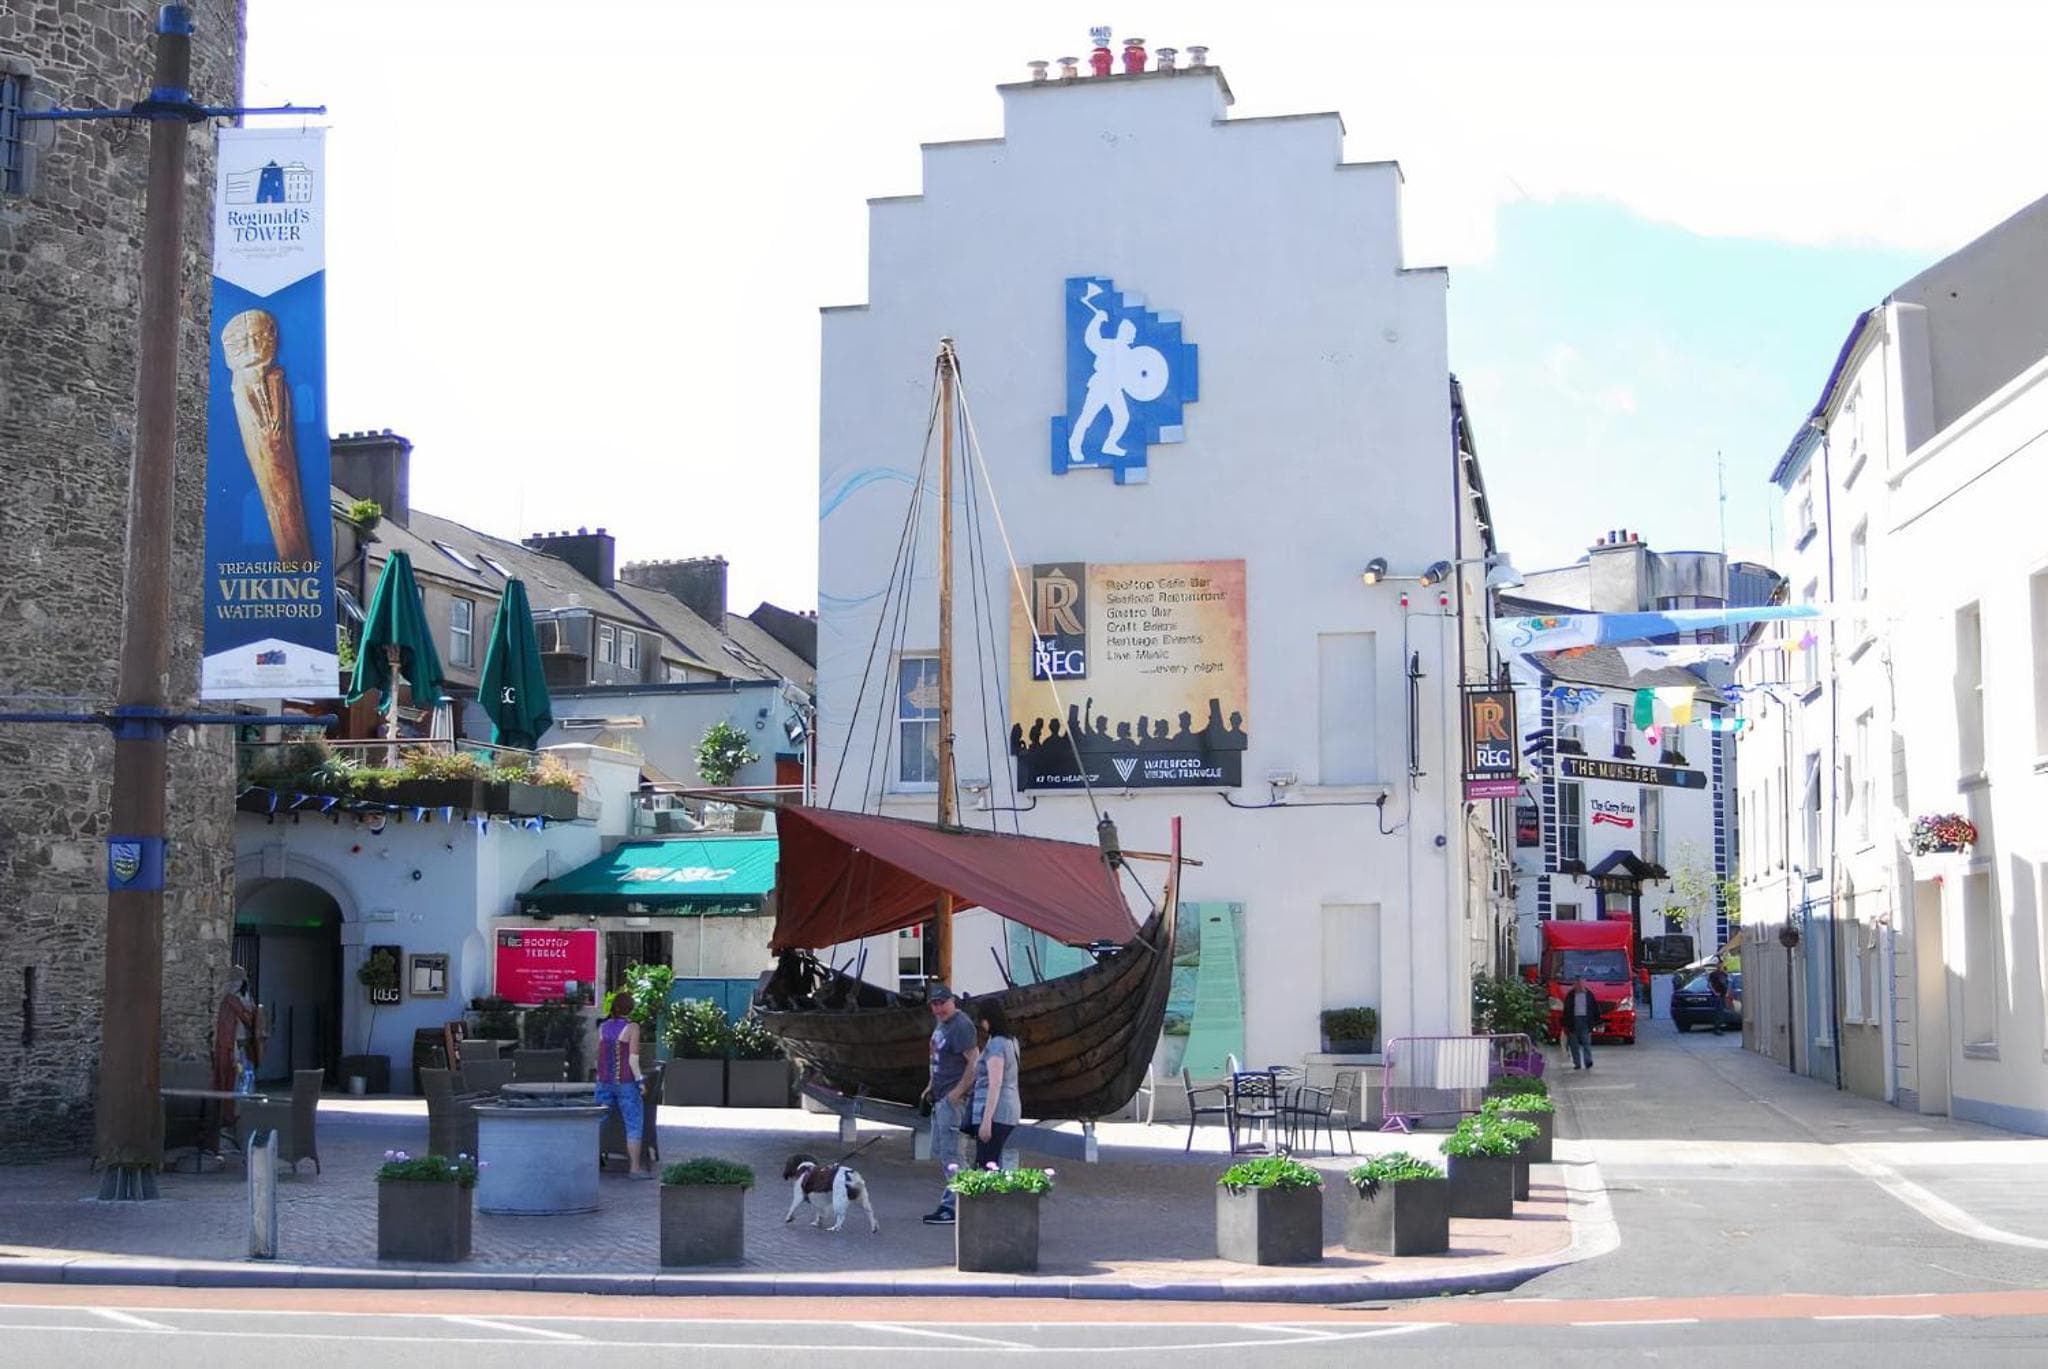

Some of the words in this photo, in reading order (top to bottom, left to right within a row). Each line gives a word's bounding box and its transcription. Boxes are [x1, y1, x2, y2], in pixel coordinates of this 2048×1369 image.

[227, 208, 310, 227] Reginald's
[234, 225, 301, 242] TOWER
[217, 561, 300, 575] TREASURES
[302, 561, 322, 574] OF
[219, 577, 322, 601] VIKING
[217, 604, 322, 619] WATERFORD
[1106, 621, 1137, 633] Craft
[1035, 650, 1085, 676] REG
[1193, 662, 1225, 674] night
[1477, 749, 1511, 767] REG
[1569, 760, 1596, 776] THE
[1599, 763, 1659, 783] MUNSTER
